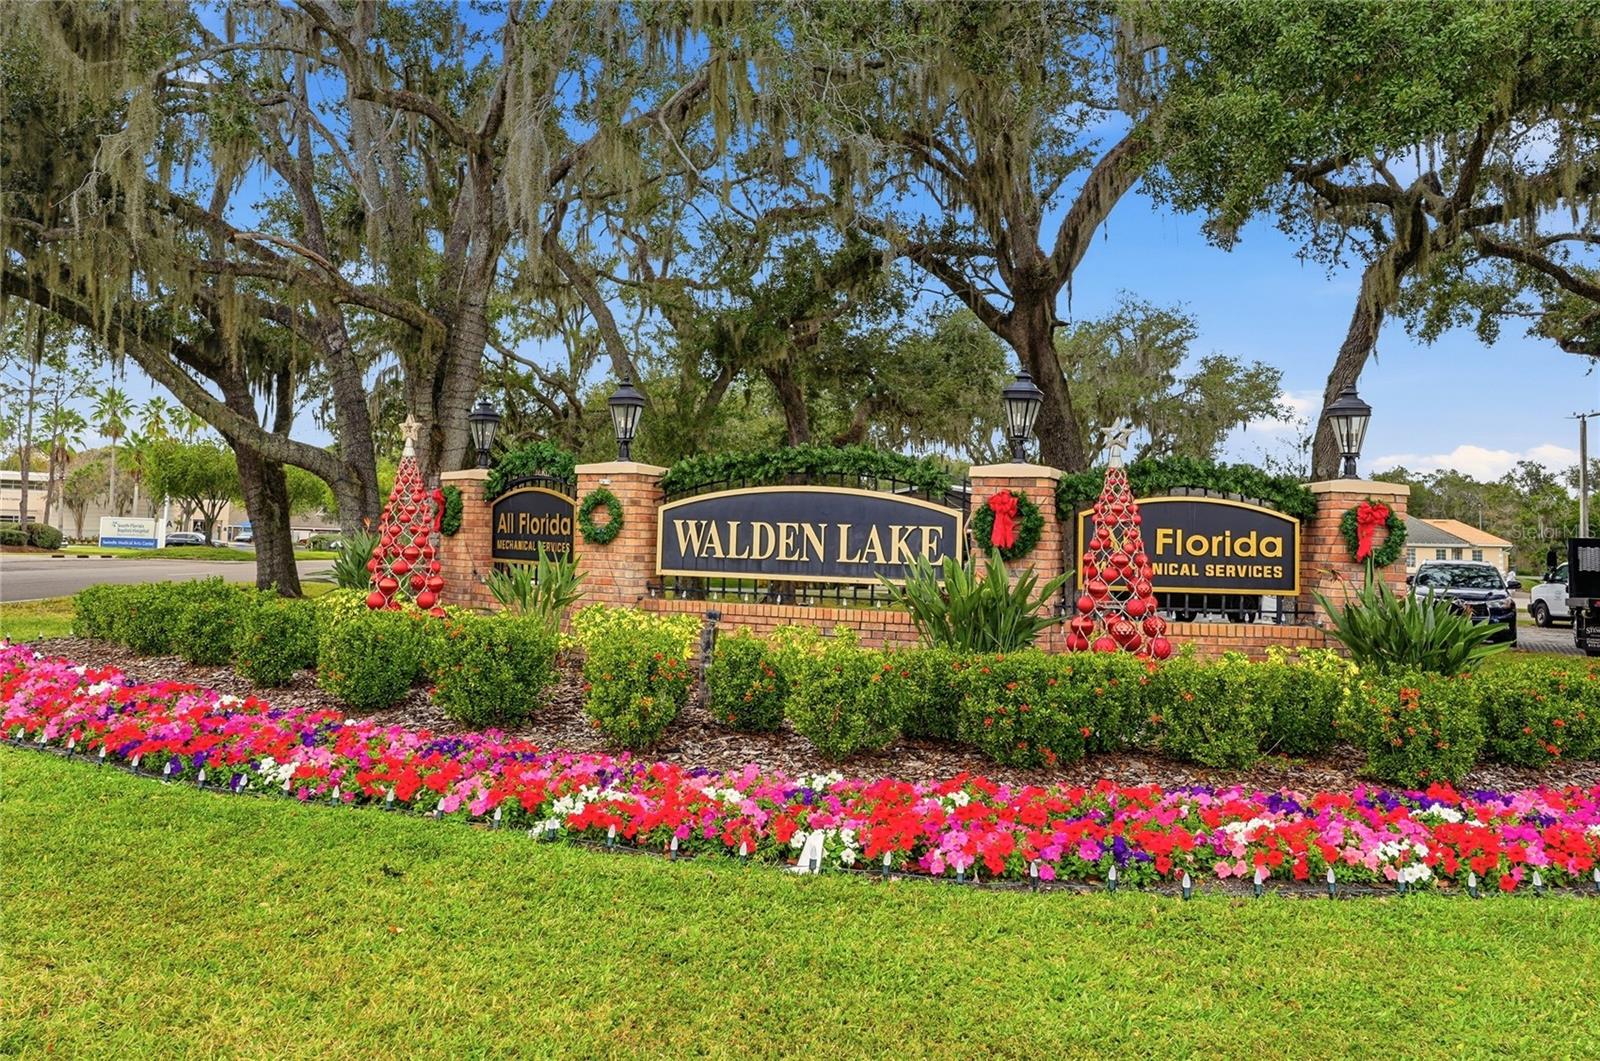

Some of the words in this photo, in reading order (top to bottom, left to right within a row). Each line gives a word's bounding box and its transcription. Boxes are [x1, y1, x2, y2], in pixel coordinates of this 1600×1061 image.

[497, 512, 514, 534] All
[519, 512, 570, 535] Florida
[496, 540, 536, 551] MECHANICAL
[540, 540, 571, 553] ERVICES
[673, 519, 828, 563] WALDEN
[836, 523, 945, 566] LAKE
[1155, 527, 1283, 558] Florida
[1151, 562, 1200, 577] NICAL
[1205, 563, 1283, 578] SERVICES
